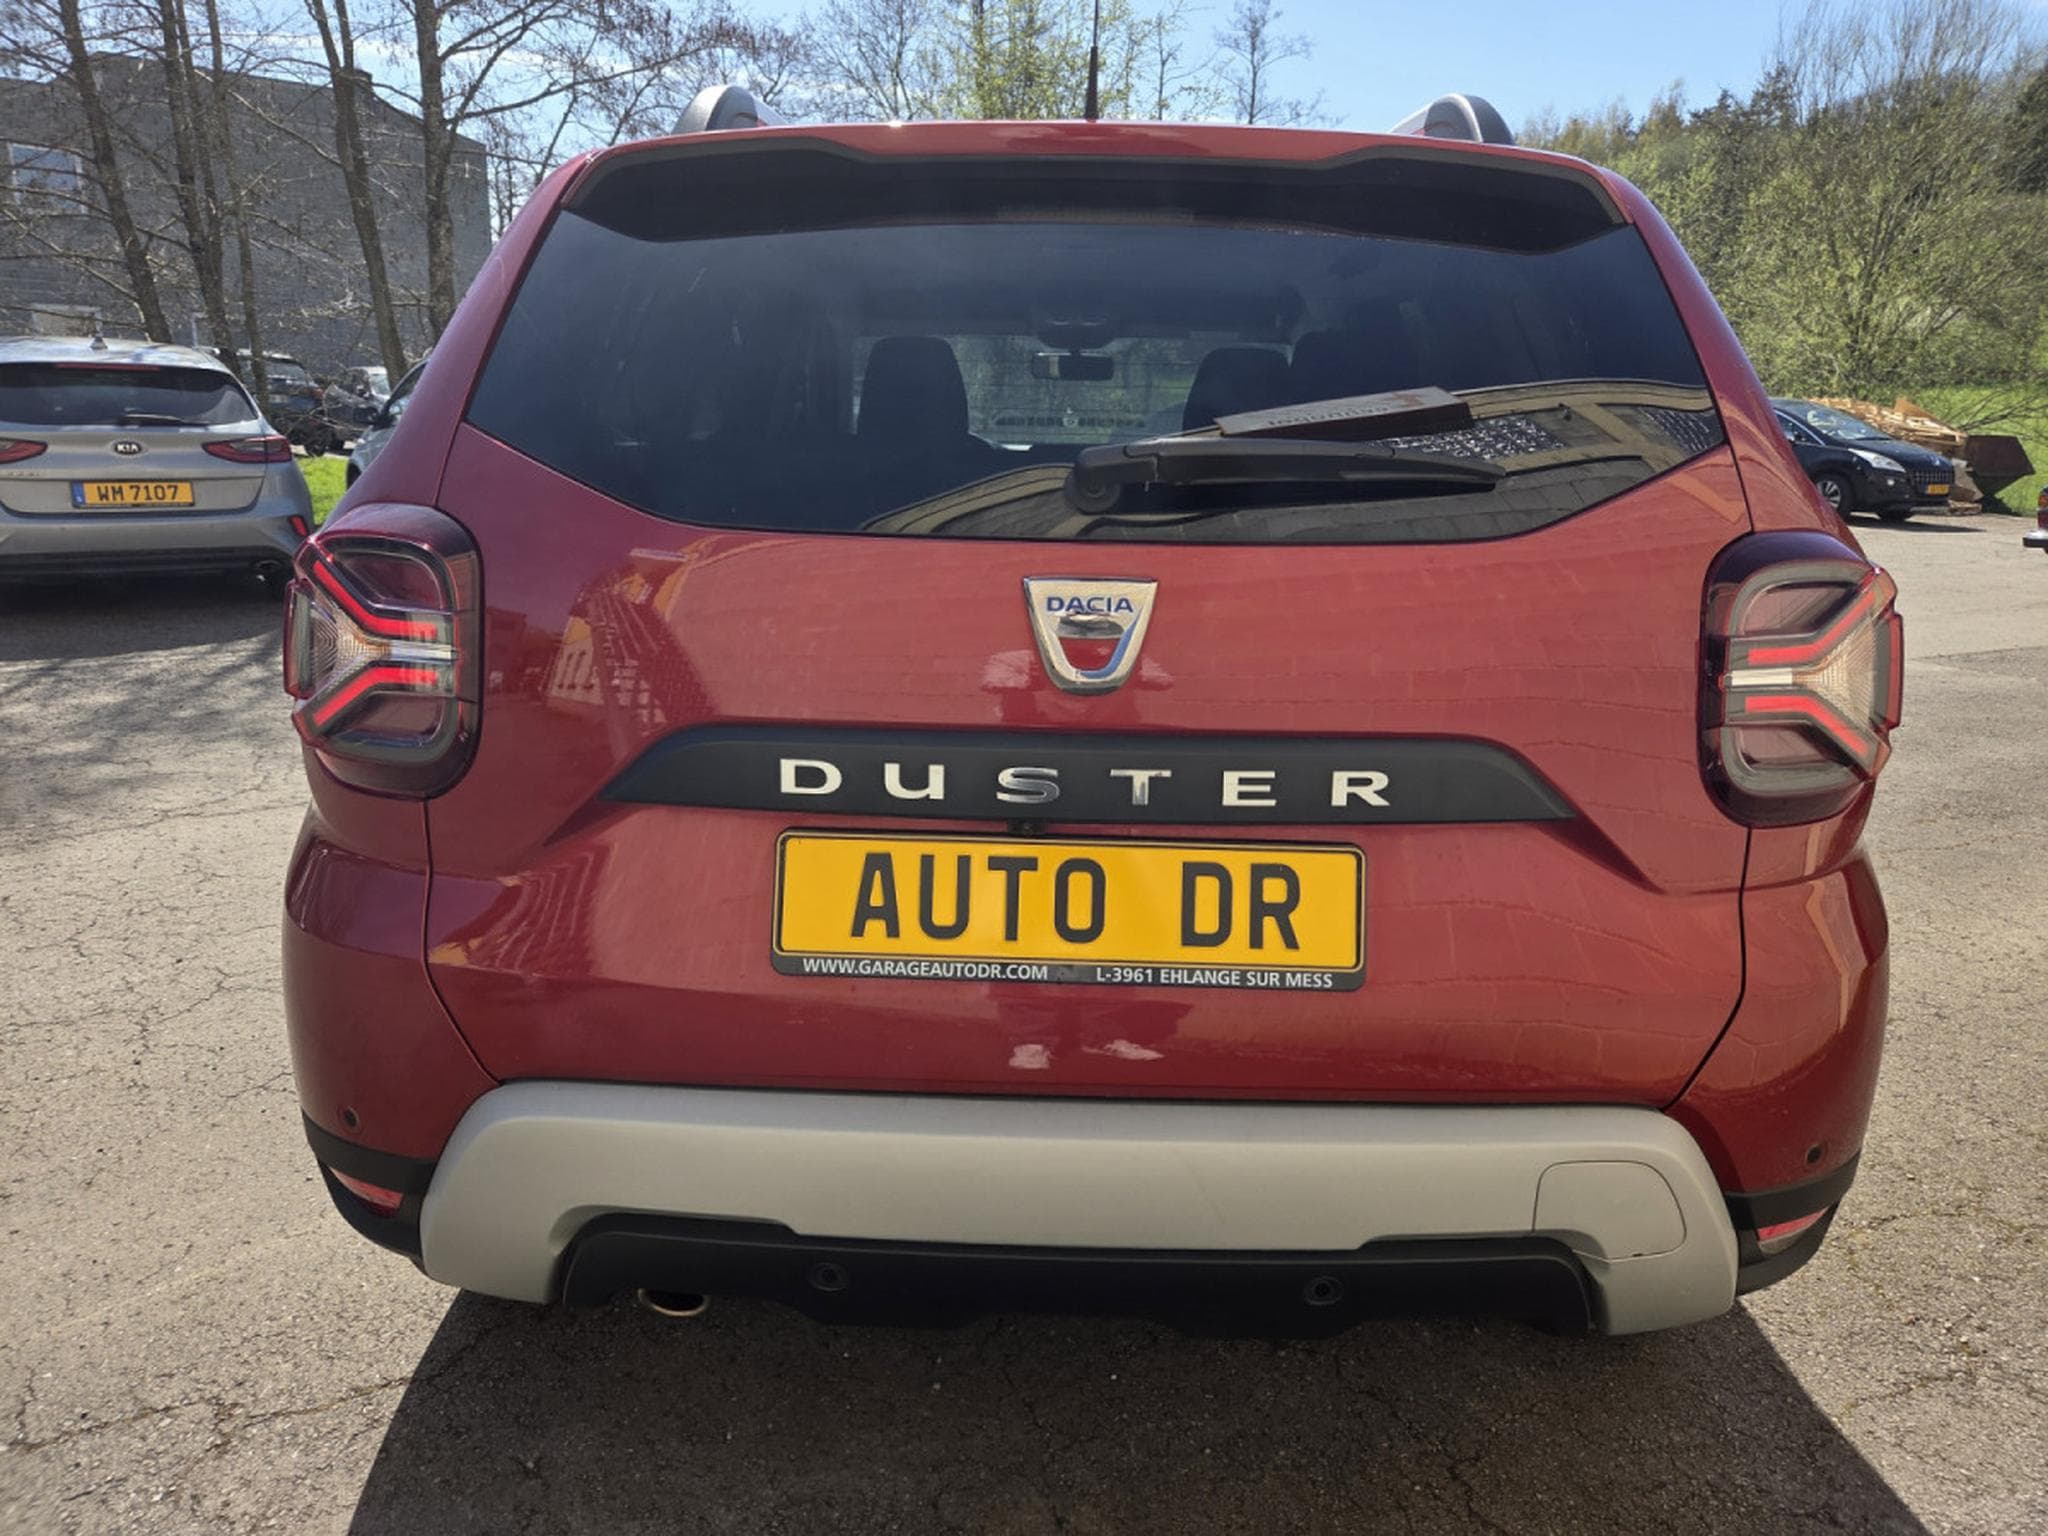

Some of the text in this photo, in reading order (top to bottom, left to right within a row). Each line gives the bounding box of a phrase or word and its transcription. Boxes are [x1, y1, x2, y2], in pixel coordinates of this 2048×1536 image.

[117, 442, 138, 452] KIA
[97, 485, 178, 501] WM 7107
[1046, 597, 1133, 613] DACIA
[779, 758, 1391, 807] DUSTER
[850, 852, 1301, 950] AUTO DR
[803, 957, 1049, 981] WWW.GARAGEAUTODR.COM
[1096, 966, 1333, 989] L-3961 EHLANGE SUR MESS
